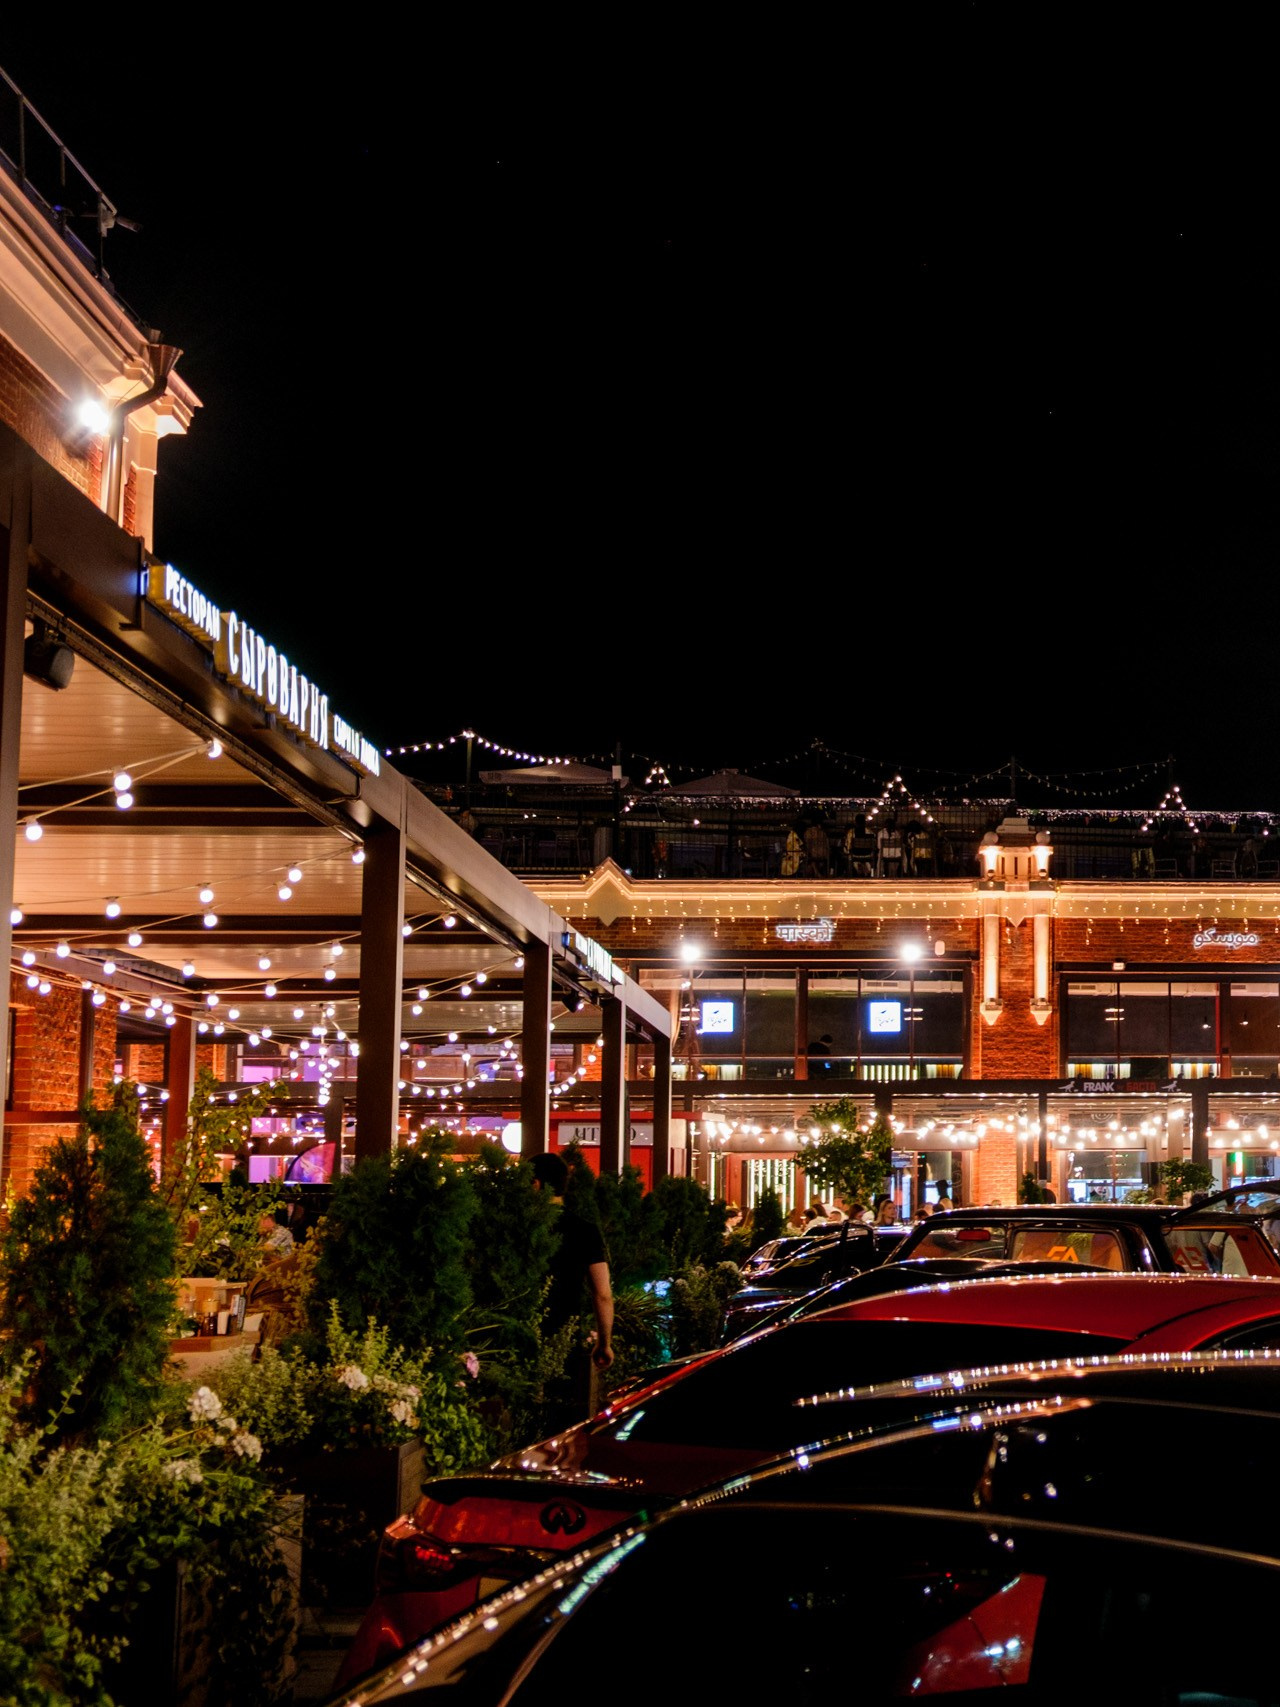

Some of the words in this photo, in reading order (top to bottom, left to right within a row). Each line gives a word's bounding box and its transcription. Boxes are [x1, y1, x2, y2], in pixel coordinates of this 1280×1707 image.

[166, 563, 220, 641] РЕСТОРАН
[228, 610, 328, 750] СЫРОВАРНЯ
[1083, 1082, 1114, 1091] FRANK
